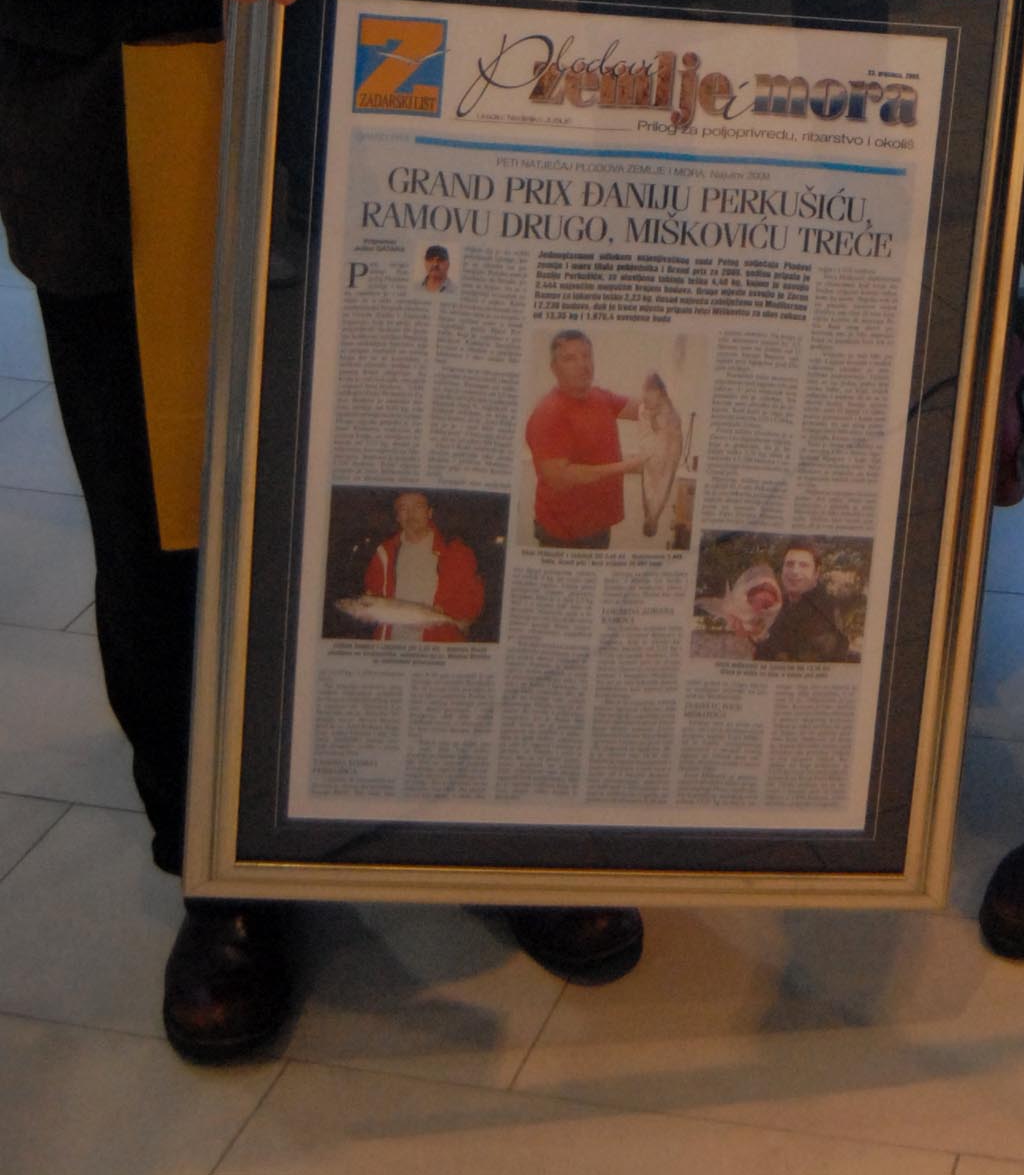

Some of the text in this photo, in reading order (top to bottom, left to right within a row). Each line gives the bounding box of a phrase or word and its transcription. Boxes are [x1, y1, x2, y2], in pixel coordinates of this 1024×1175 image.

[359, 92, 437, 110] ZADARSKI LIST
[750, 72, 919, 127] mora
[636, 118, 677, 136] Prilog
[701, 126, 799, 144] poljoprivredu,
[801, 131, 864, 147] ribarstvo
[388, 165, 496, 202] GRAND
[504, 175, 574, 207] PRIX
[700, 184, 873, 225] PERKUŠIĆU,
[360, 199, 894, 259] RAMOVU DRUGO, MIŠKOVIĆU TREĆE
